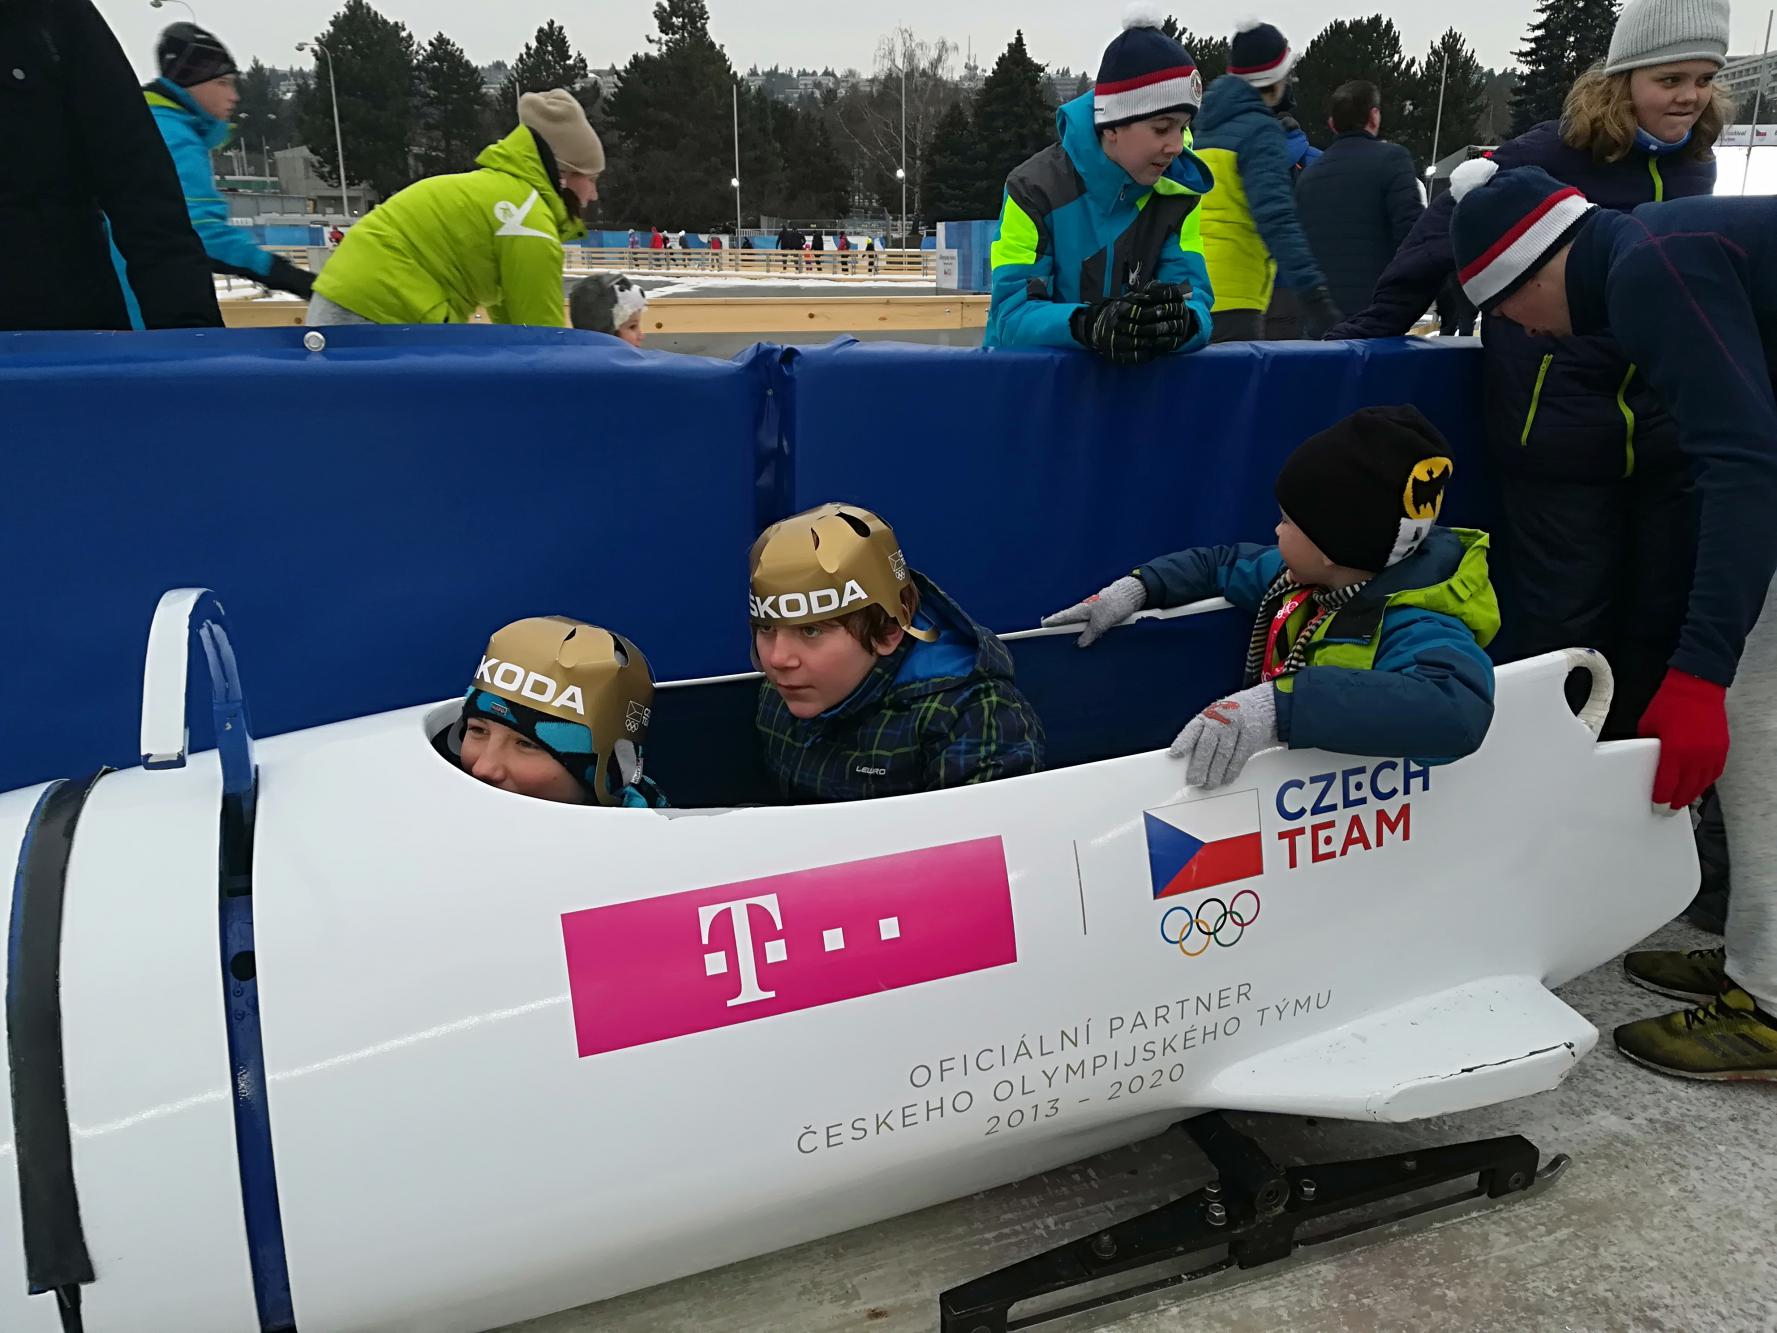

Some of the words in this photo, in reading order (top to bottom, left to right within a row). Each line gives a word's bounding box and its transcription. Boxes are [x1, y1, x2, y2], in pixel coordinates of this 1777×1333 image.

[475, 655, 584, 715] KODA
[856, 765, 886, 776] LEWRO
[1276, 758, 1430, 821] CZECH
[1278, 802, 1410, 869] TEAM
[910, 1017, 1091, 1088] OFICIÁLNÍ
[1109, 982, 1252, 1039] PARTNER
[993, 1016, 1241, 1101] OLYMPIJSKÉHO
[1257, 989, 1332, 1026] TÝMU
[984, 1098, 1060, 1136] 2013
[1107, 1063, 1185, 1100] 2020
